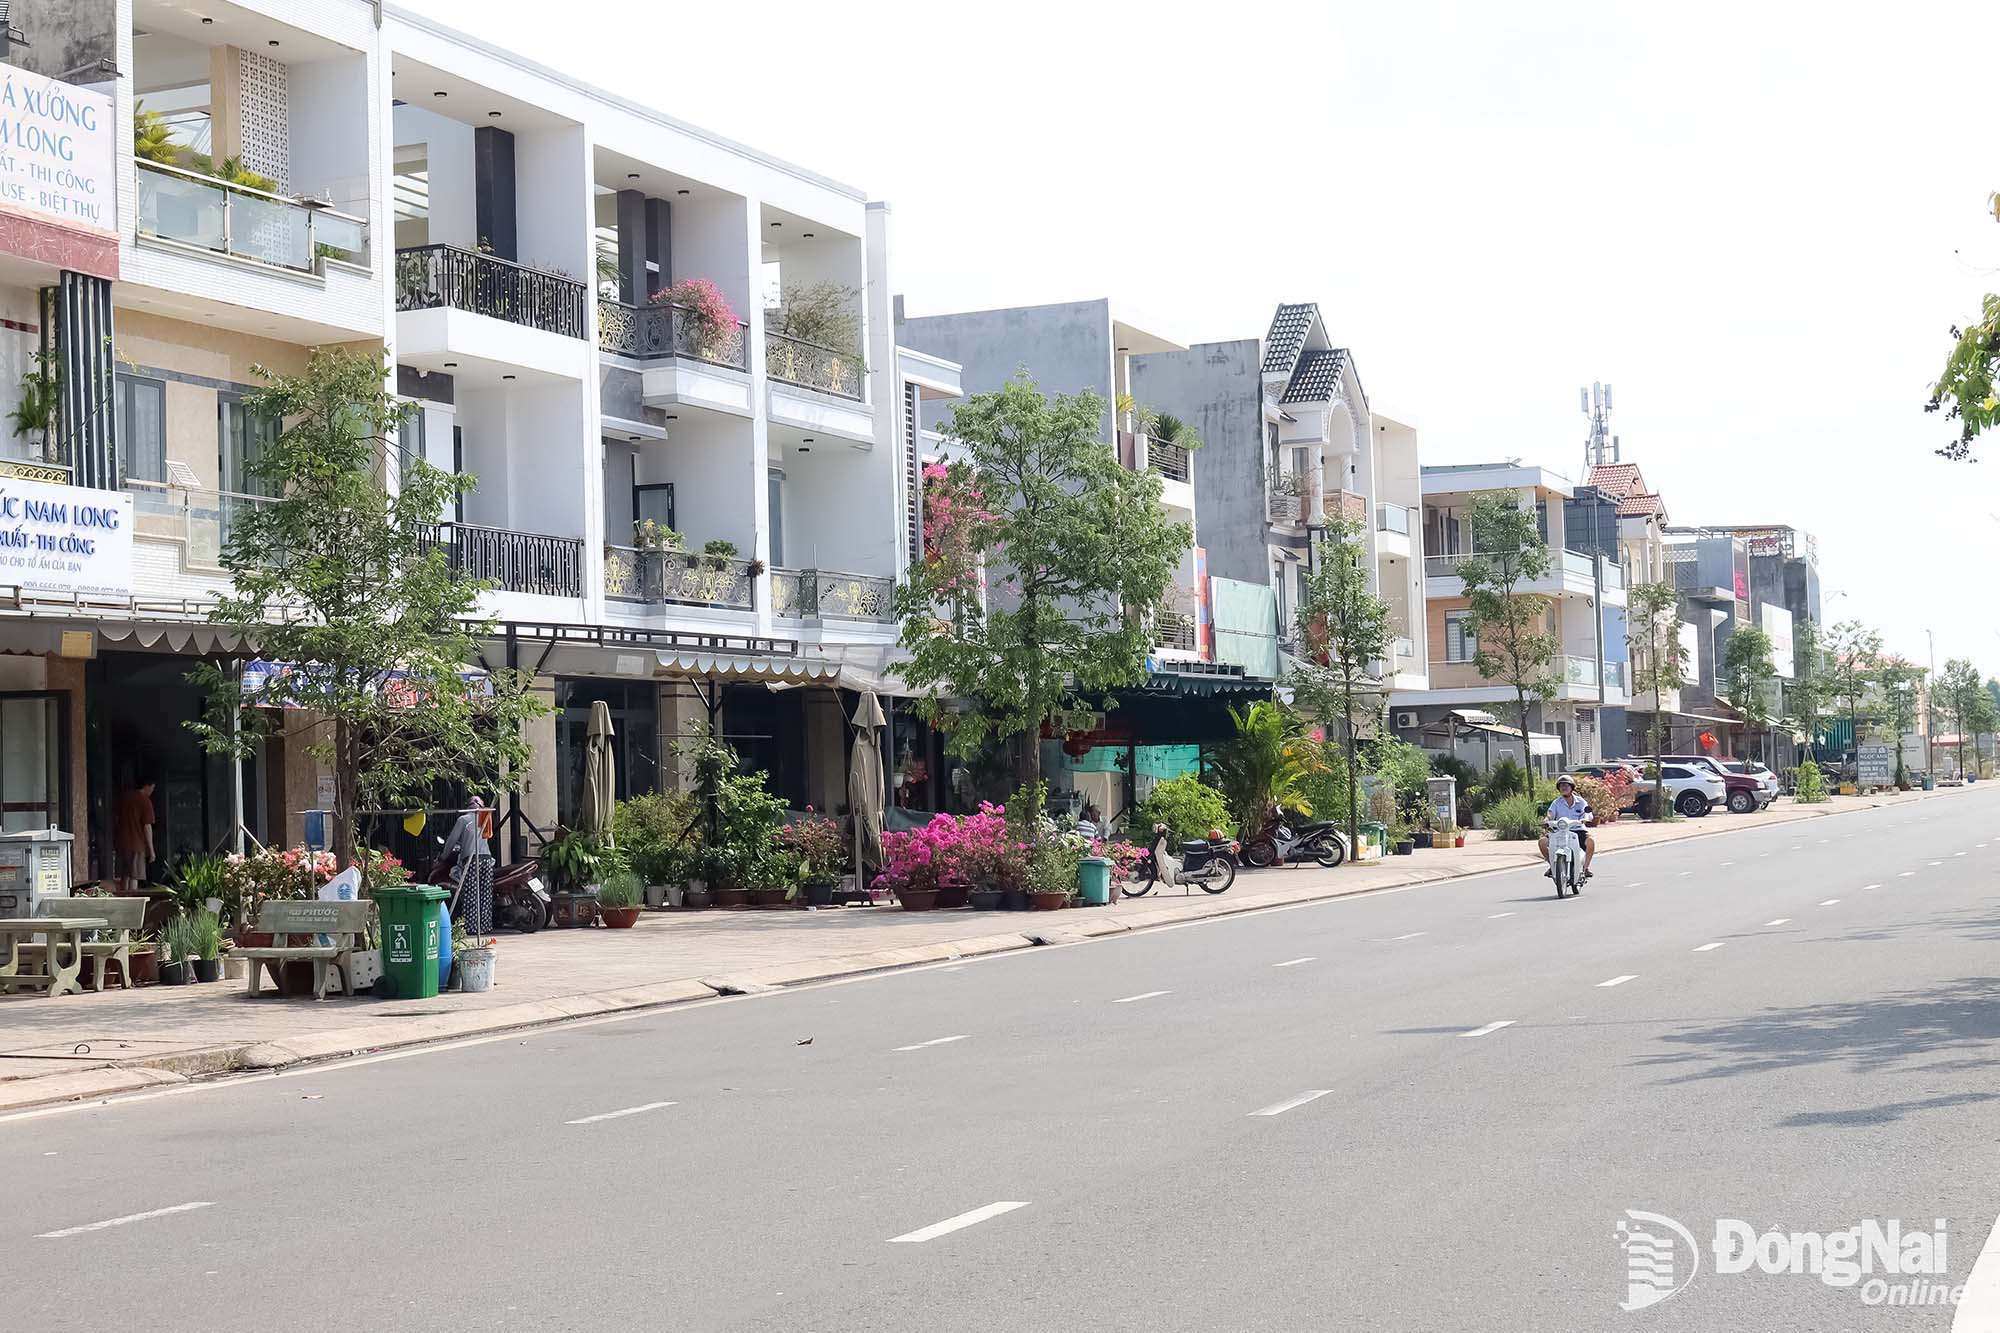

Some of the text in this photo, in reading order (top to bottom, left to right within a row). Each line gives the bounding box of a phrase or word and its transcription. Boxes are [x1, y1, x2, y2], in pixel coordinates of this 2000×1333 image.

[23, 86, 96, 131] XƯỞNG
[16, 122, 73, 161] LONG
[29, 162, 51, 183] THI
[56, 168, 95, 194] CÔNG
[1, 180, 25, 201] USE
[40, 190, 67, 214] BIỆT
[25, 499, 68, 525] NAM
[73, 505, 119, 530] LONG
[59, 531, 96, 556] CÔNG
